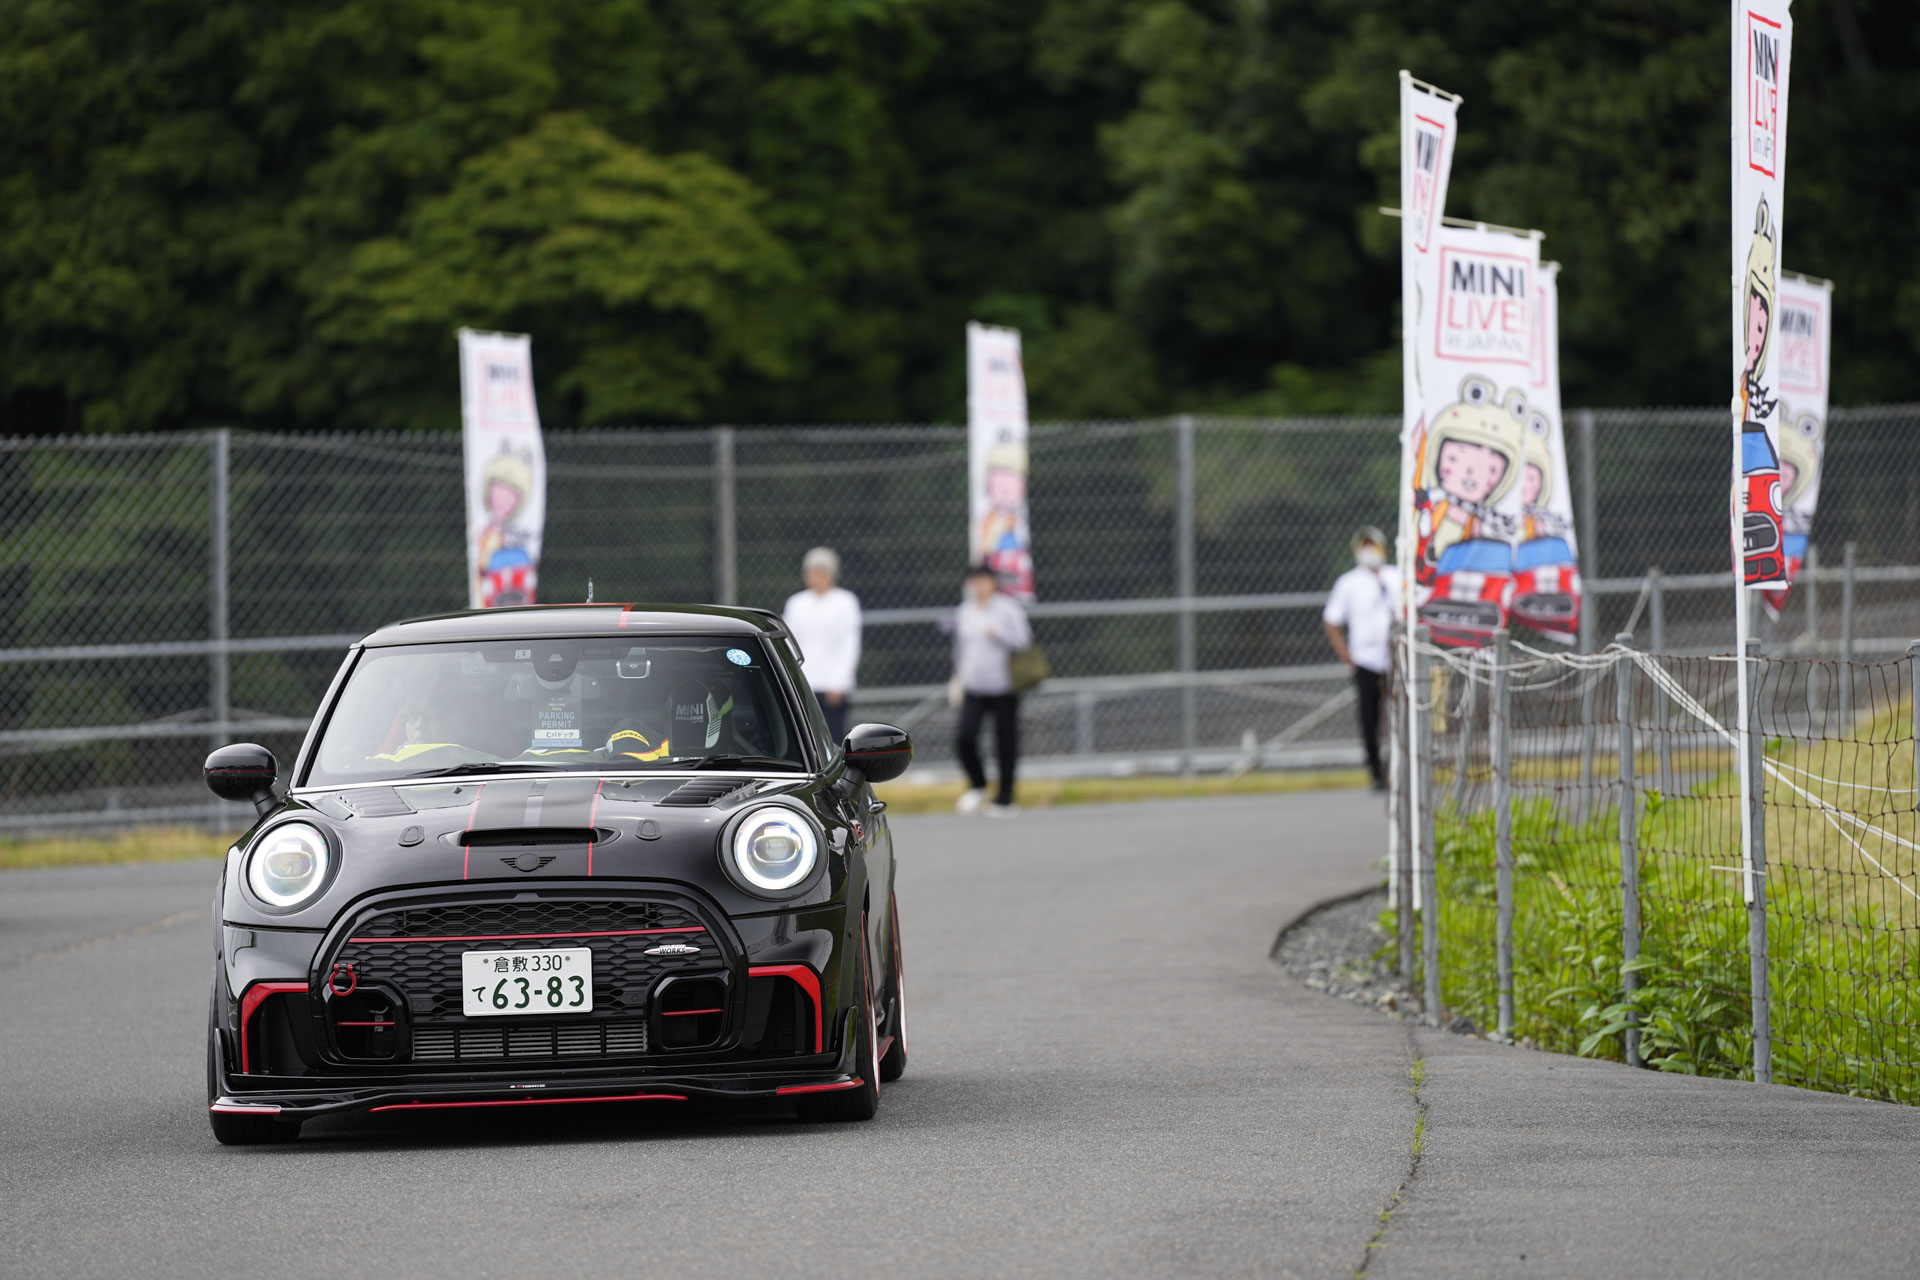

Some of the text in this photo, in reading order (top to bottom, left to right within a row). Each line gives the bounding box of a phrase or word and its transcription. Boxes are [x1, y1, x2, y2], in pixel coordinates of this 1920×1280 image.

[1452, 260, 1525, 298] MINI
[539, 711, 575, 720] PARKING
[676, 703, 704, 715] MINI
[541, 720, 573, 728] PERMIT
[494, 954, 562, 973] 倉敷 330
[471, 975, 585, 1009] て 63-83
